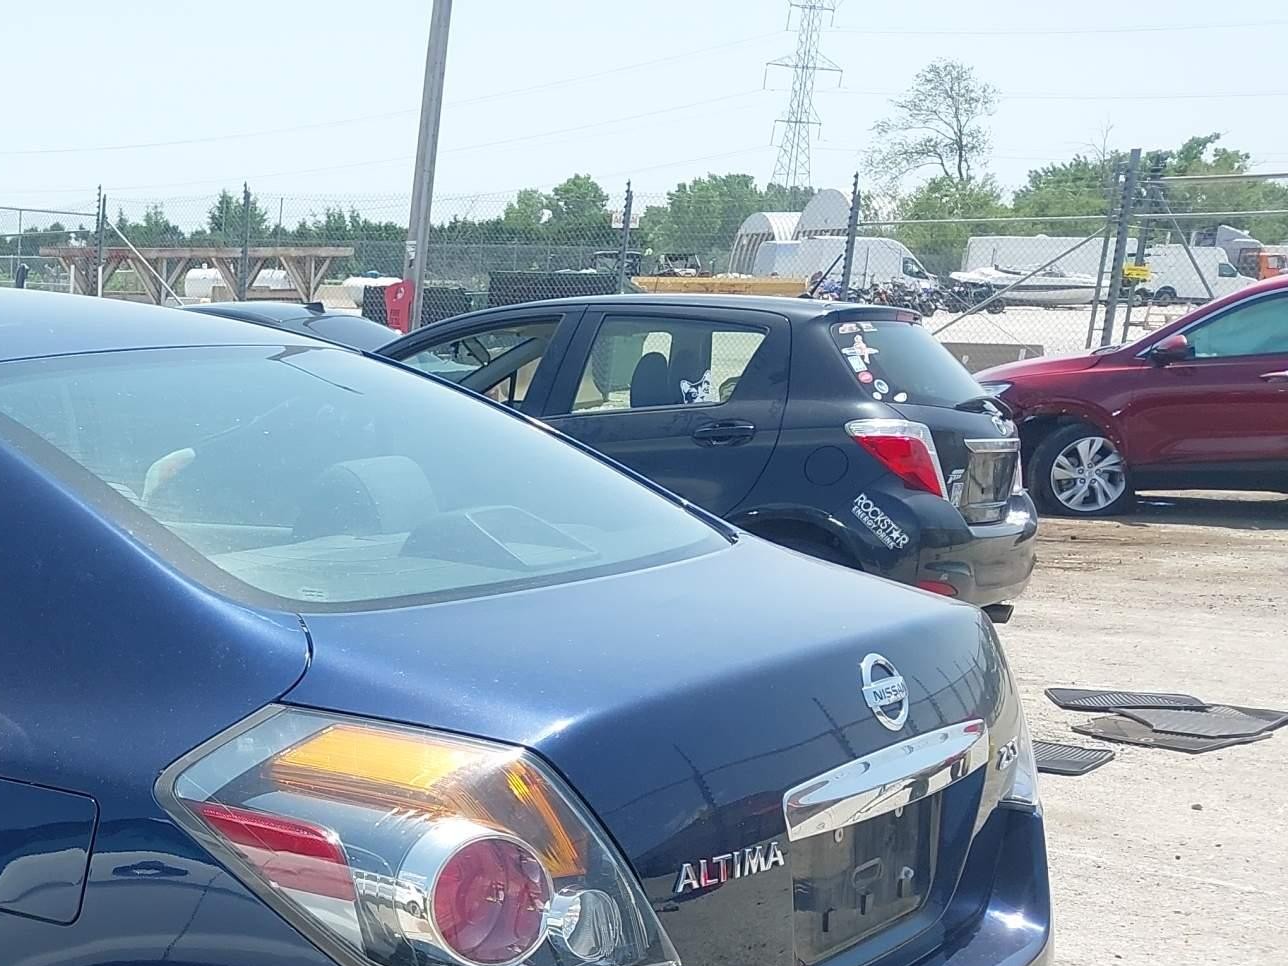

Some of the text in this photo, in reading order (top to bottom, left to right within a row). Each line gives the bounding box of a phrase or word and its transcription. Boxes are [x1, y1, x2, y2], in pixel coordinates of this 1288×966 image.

[850, 505, 896, 551] ENERGY DRINK
[673, 841, 785, 893] ALTIMA
